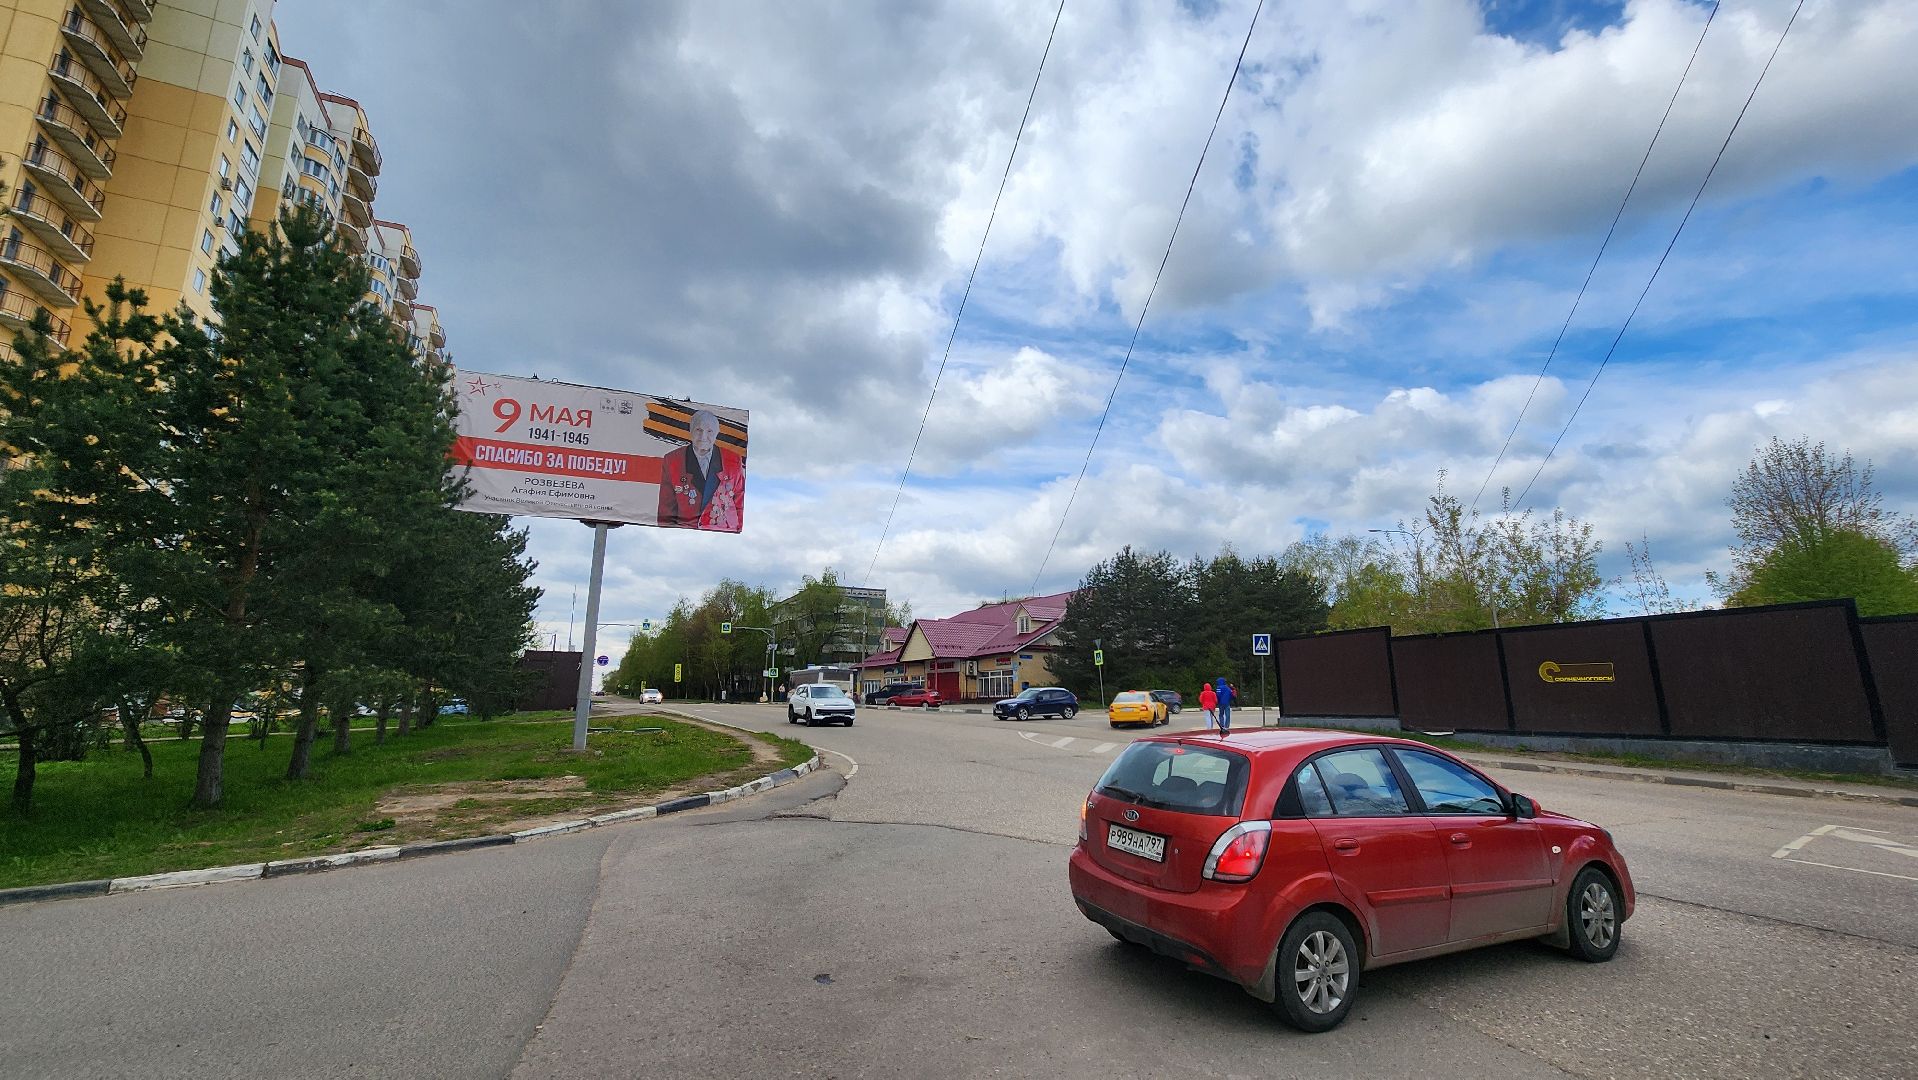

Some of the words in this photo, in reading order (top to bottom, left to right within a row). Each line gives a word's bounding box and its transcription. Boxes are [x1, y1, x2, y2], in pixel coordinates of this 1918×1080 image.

[493, 398, 521, 433] 9
[530, 403, 592, 428] МАЯ
[528, 427, 589, 445] 1941-1945
[475, 444, 543, 469] СПАСИБО
[546, 453, 564, 470] ЗА
[567, 454, 627, 475] ПОБЕДУ!
[524, 477, 585, 490] РОЗВЕЗЕВА
[511, 485, 546, 498] Агафия
[548, 488, 595, 501] Ефимовна
